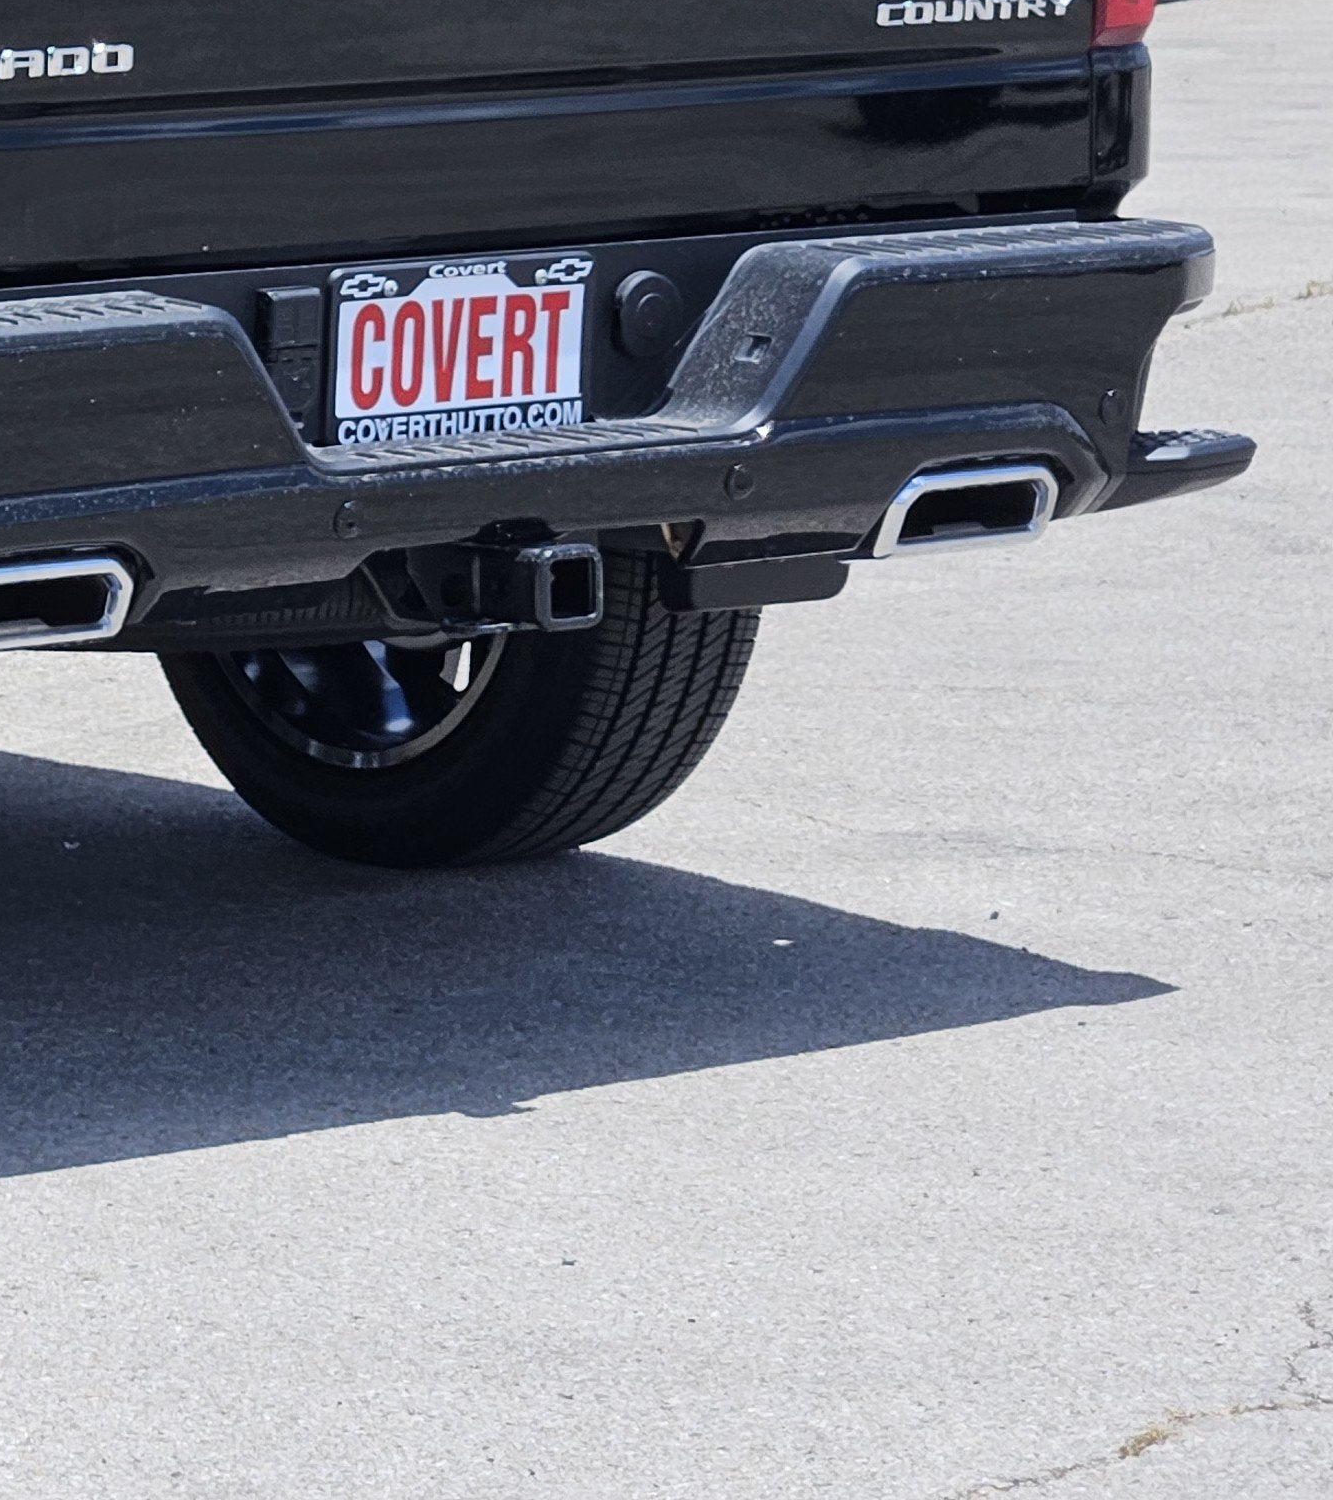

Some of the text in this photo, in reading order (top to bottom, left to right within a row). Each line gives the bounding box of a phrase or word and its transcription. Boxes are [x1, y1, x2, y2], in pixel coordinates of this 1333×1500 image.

[429, 260, 508, 279] Covert
[351, 290, 571, 411] COVERT
[338, 399, 583, 445] COVERTHUTTO.COM
